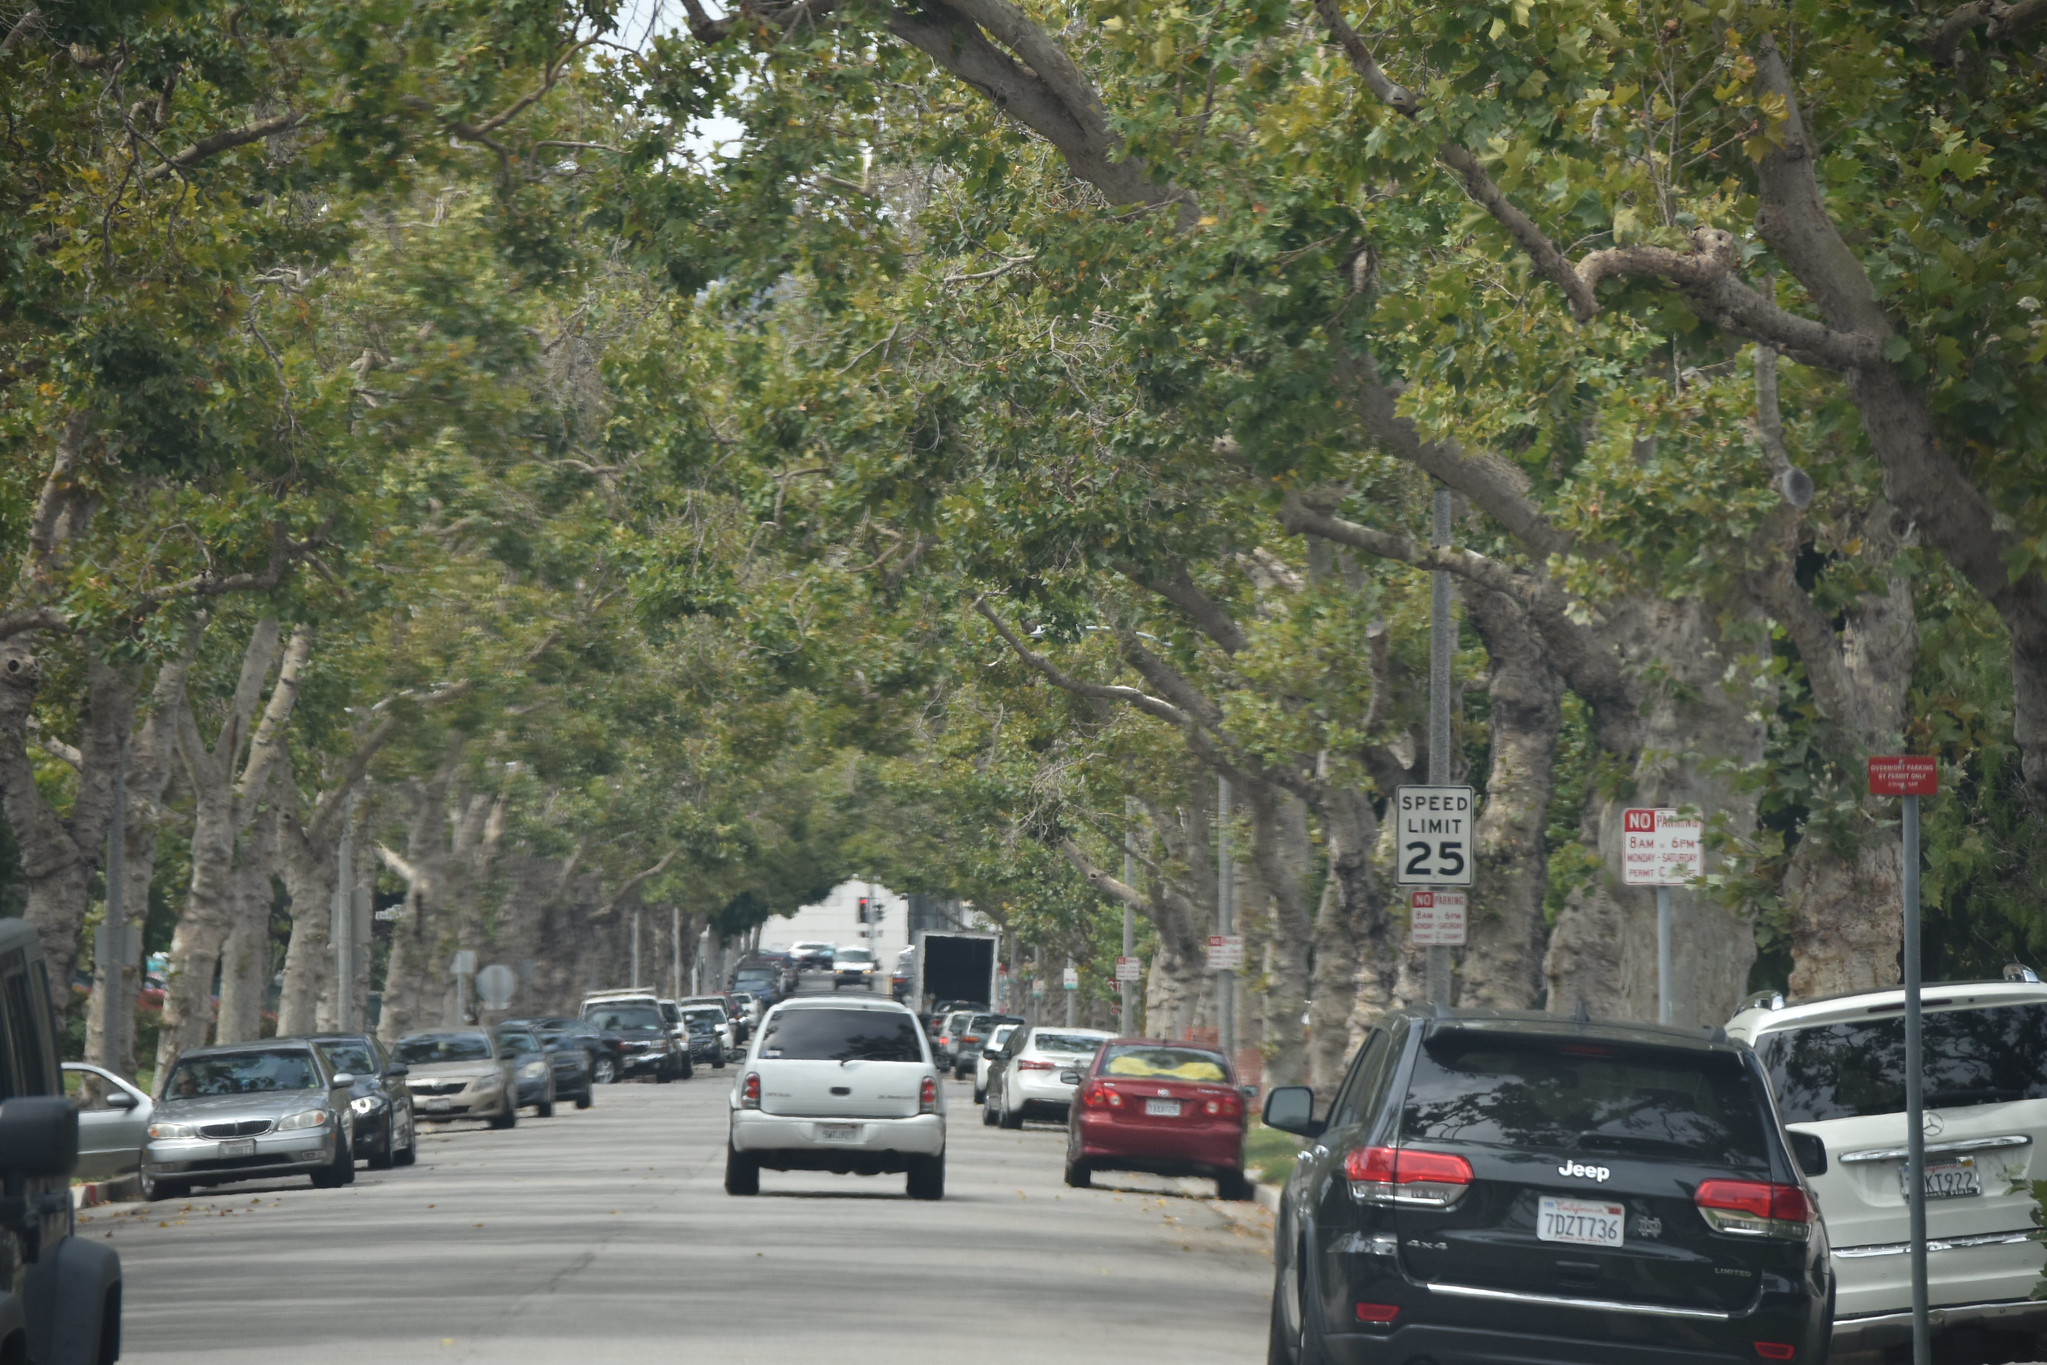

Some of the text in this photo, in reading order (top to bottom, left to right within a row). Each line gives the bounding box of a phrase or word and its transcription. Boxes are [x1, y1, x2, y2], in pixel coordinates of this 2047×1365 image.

[1402, 796, 1468, 811] SPEED
[1408, 819, 1462, 834] LIMIT
[1629, 812, 1651, 829] NO
[1405, 841, 1465, 876] 25
[1416, 894, 1465, 906] NO PARKING
[1558, 1159, 1610, 1183] Jeep
[1924, 1171, 1973, 1194] KT922
[1545, 1213, 1618, 1240] 7DZT736
[1714, 1267, 1752, 1277] LIMITED
